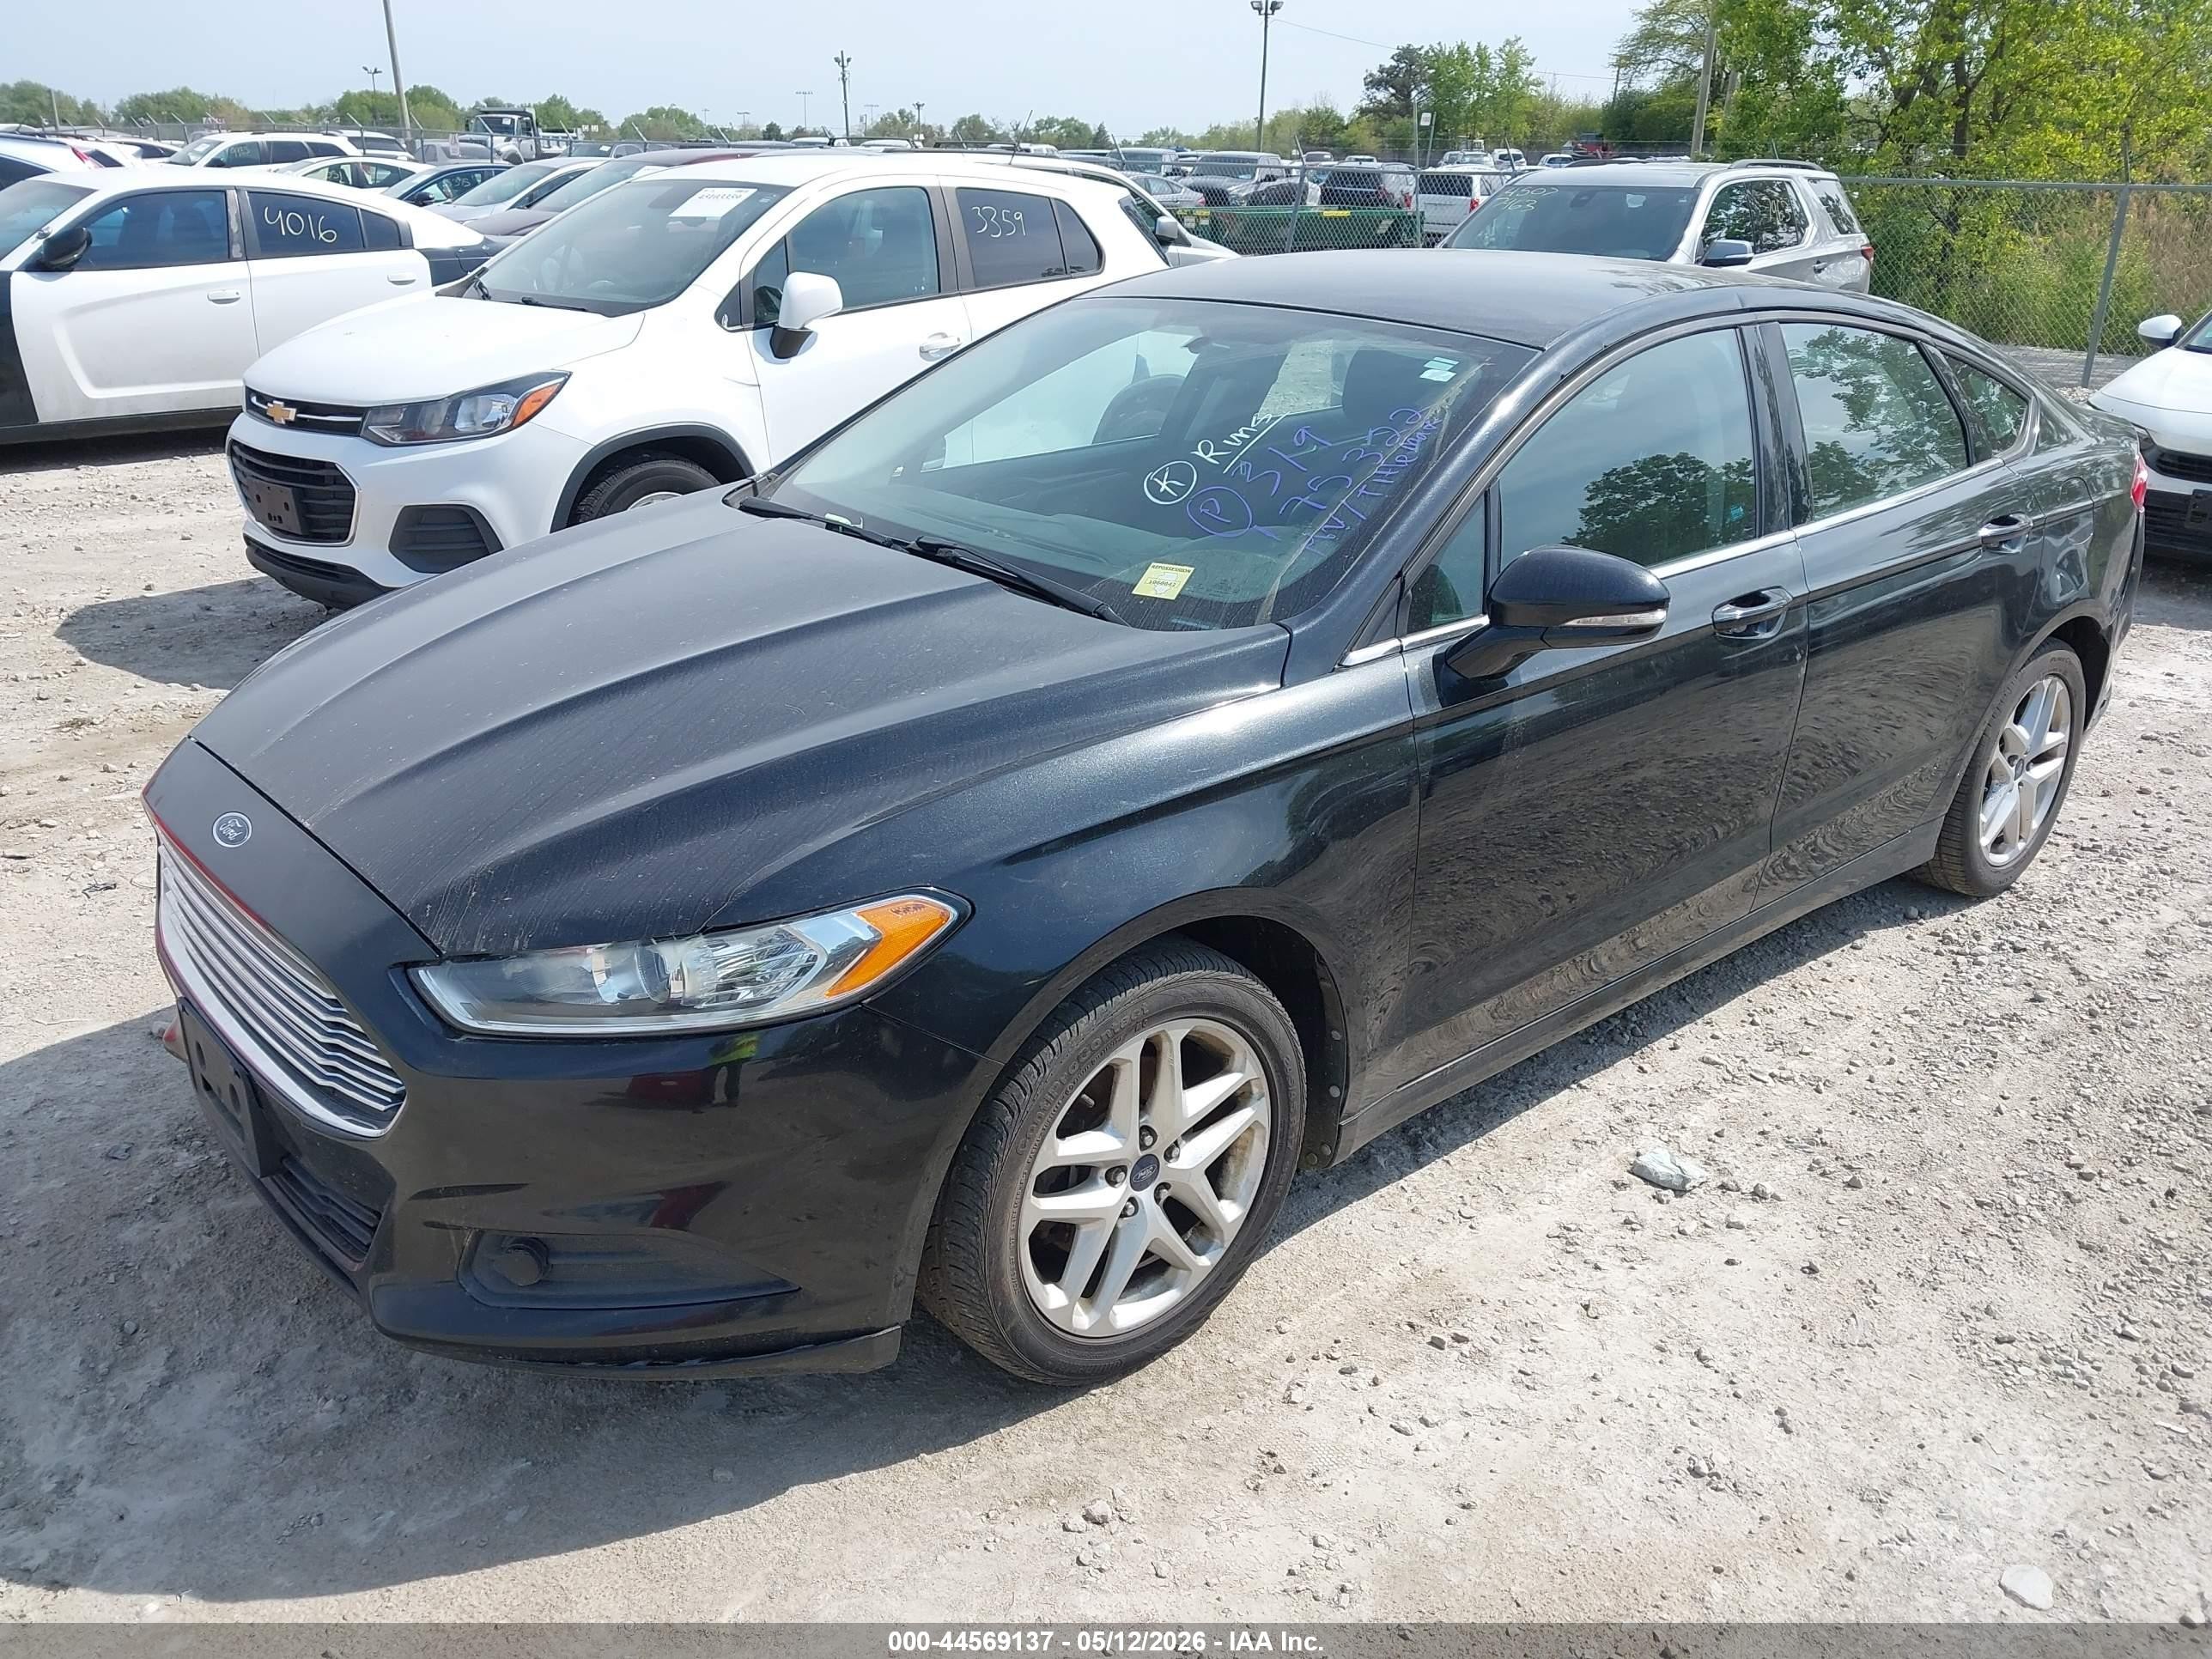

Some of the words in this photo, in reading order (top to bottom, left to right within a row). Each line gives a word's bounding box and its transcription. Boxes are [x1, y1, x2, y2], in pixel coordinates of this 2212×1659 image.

[264, 206, 337, 243] 4016
[971, 206, 1026, 238] 3359
[1152, 564, 1191, 573] REPOSSESSION
